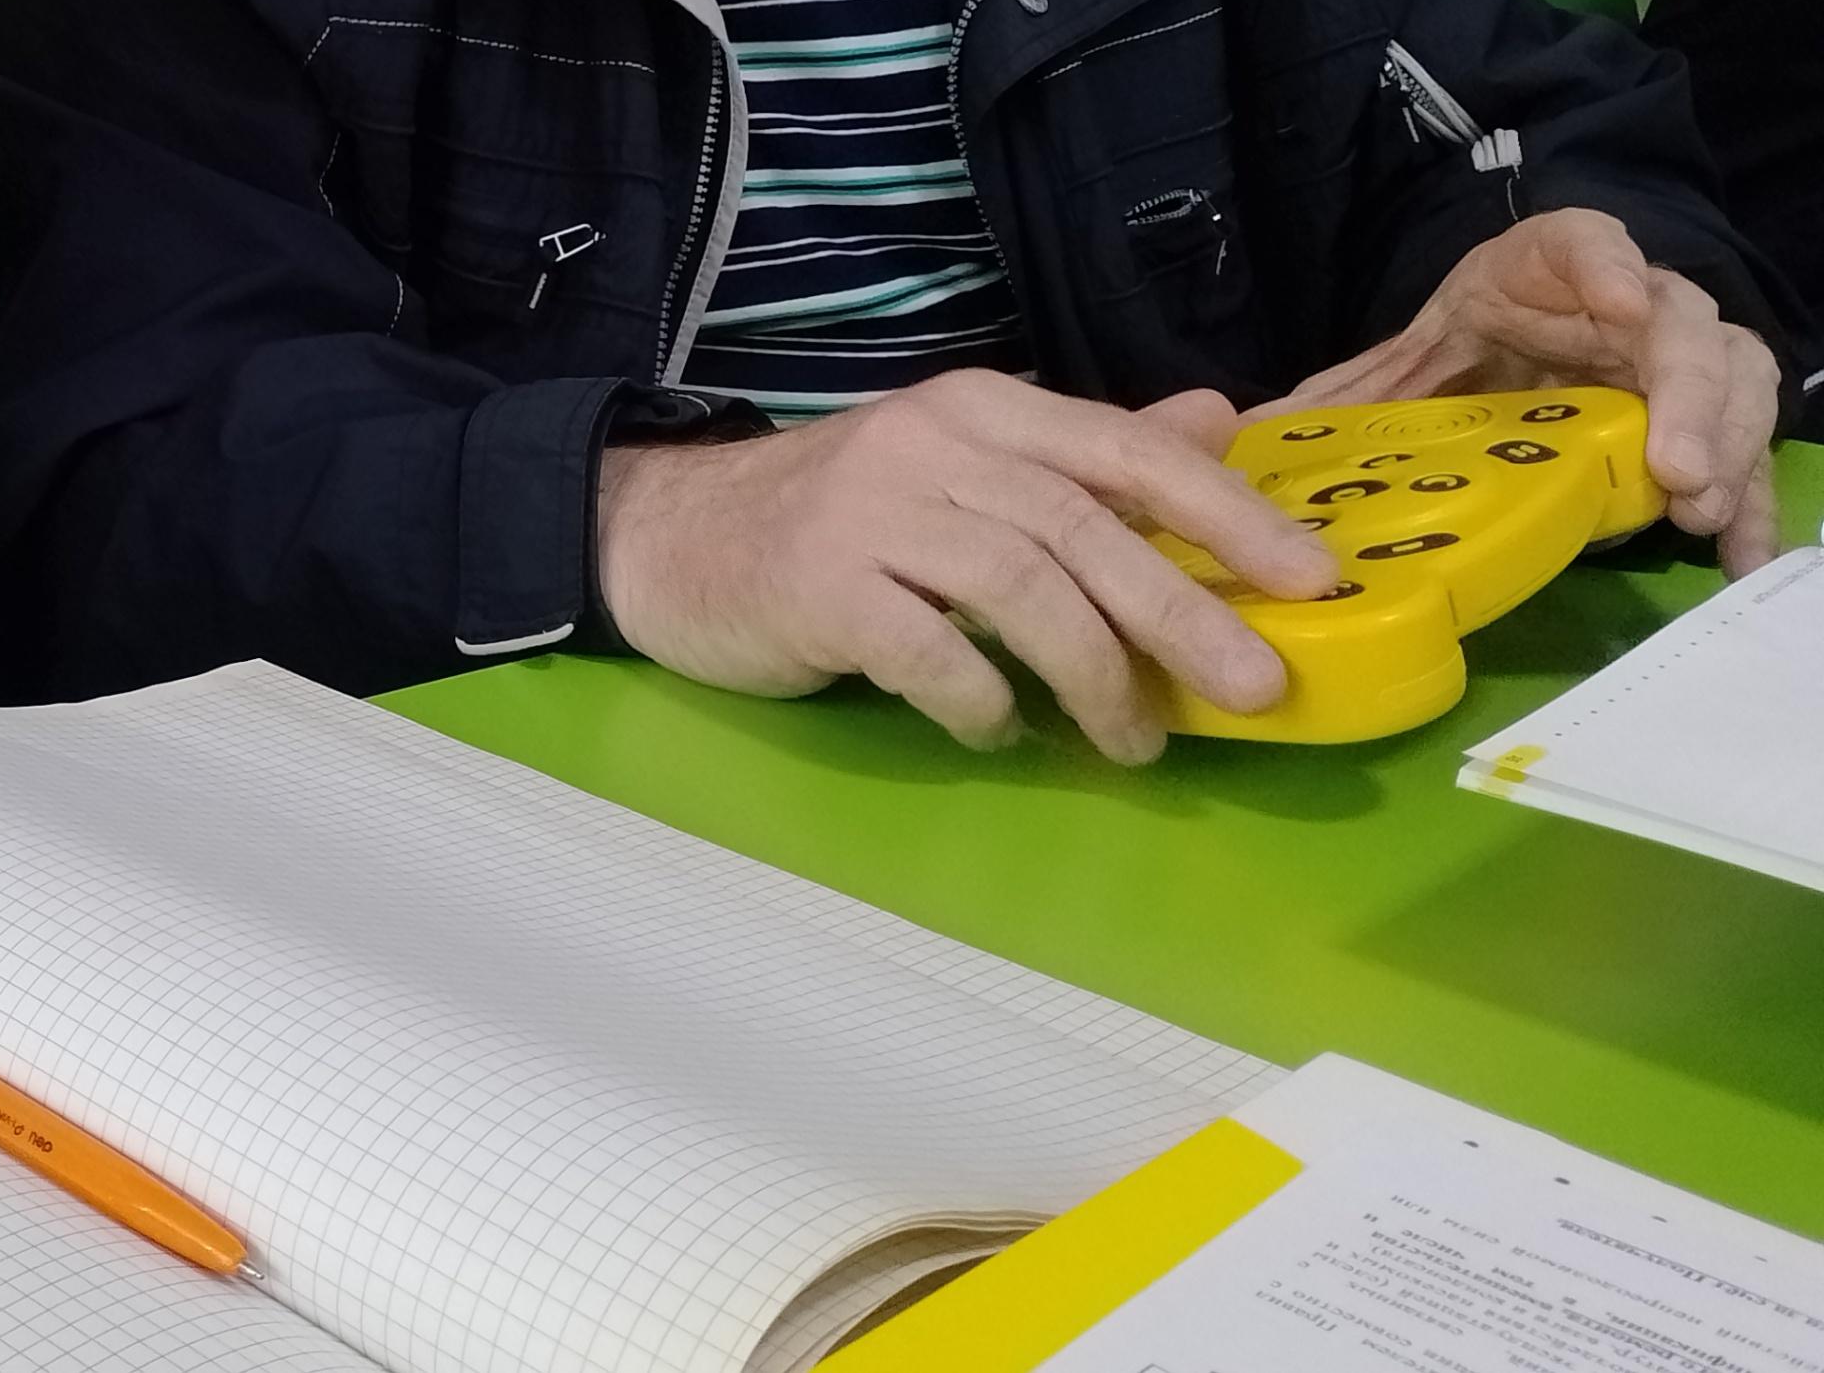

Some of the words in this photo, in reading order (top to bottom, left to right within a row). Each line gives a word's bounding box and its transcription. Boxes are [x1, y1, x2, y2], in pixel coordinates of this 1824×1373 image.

[1390, 1194, 1432, 1216] или
[1362, 1212, 1380, 1224] и
[1441, 1217, 1501, 1245] силы
[1324, 1240, 1340, 1251] и
[1399, 1229, 1467, 1261] числе
[1296, 1260, 1311, 1269] с
[1370, 1229, 1555, 1312] вмешательства
[1269, 1279, 1283, 1289] с
[1349, 1250, 1475, 1308] насекомых
[1490, 1266, 1536, 1289] том
[1510, 1245, 1704, 1326] непреодолимой
[1255, 1290, 1339, 1332] Правил
[1291, 1290, 1413, 1347] совместно
[1348, 1280, 1464, 1336] связанных
[1511, 1304, 1528, 1315] и
[1772, 1301, 1798, 1320] за
